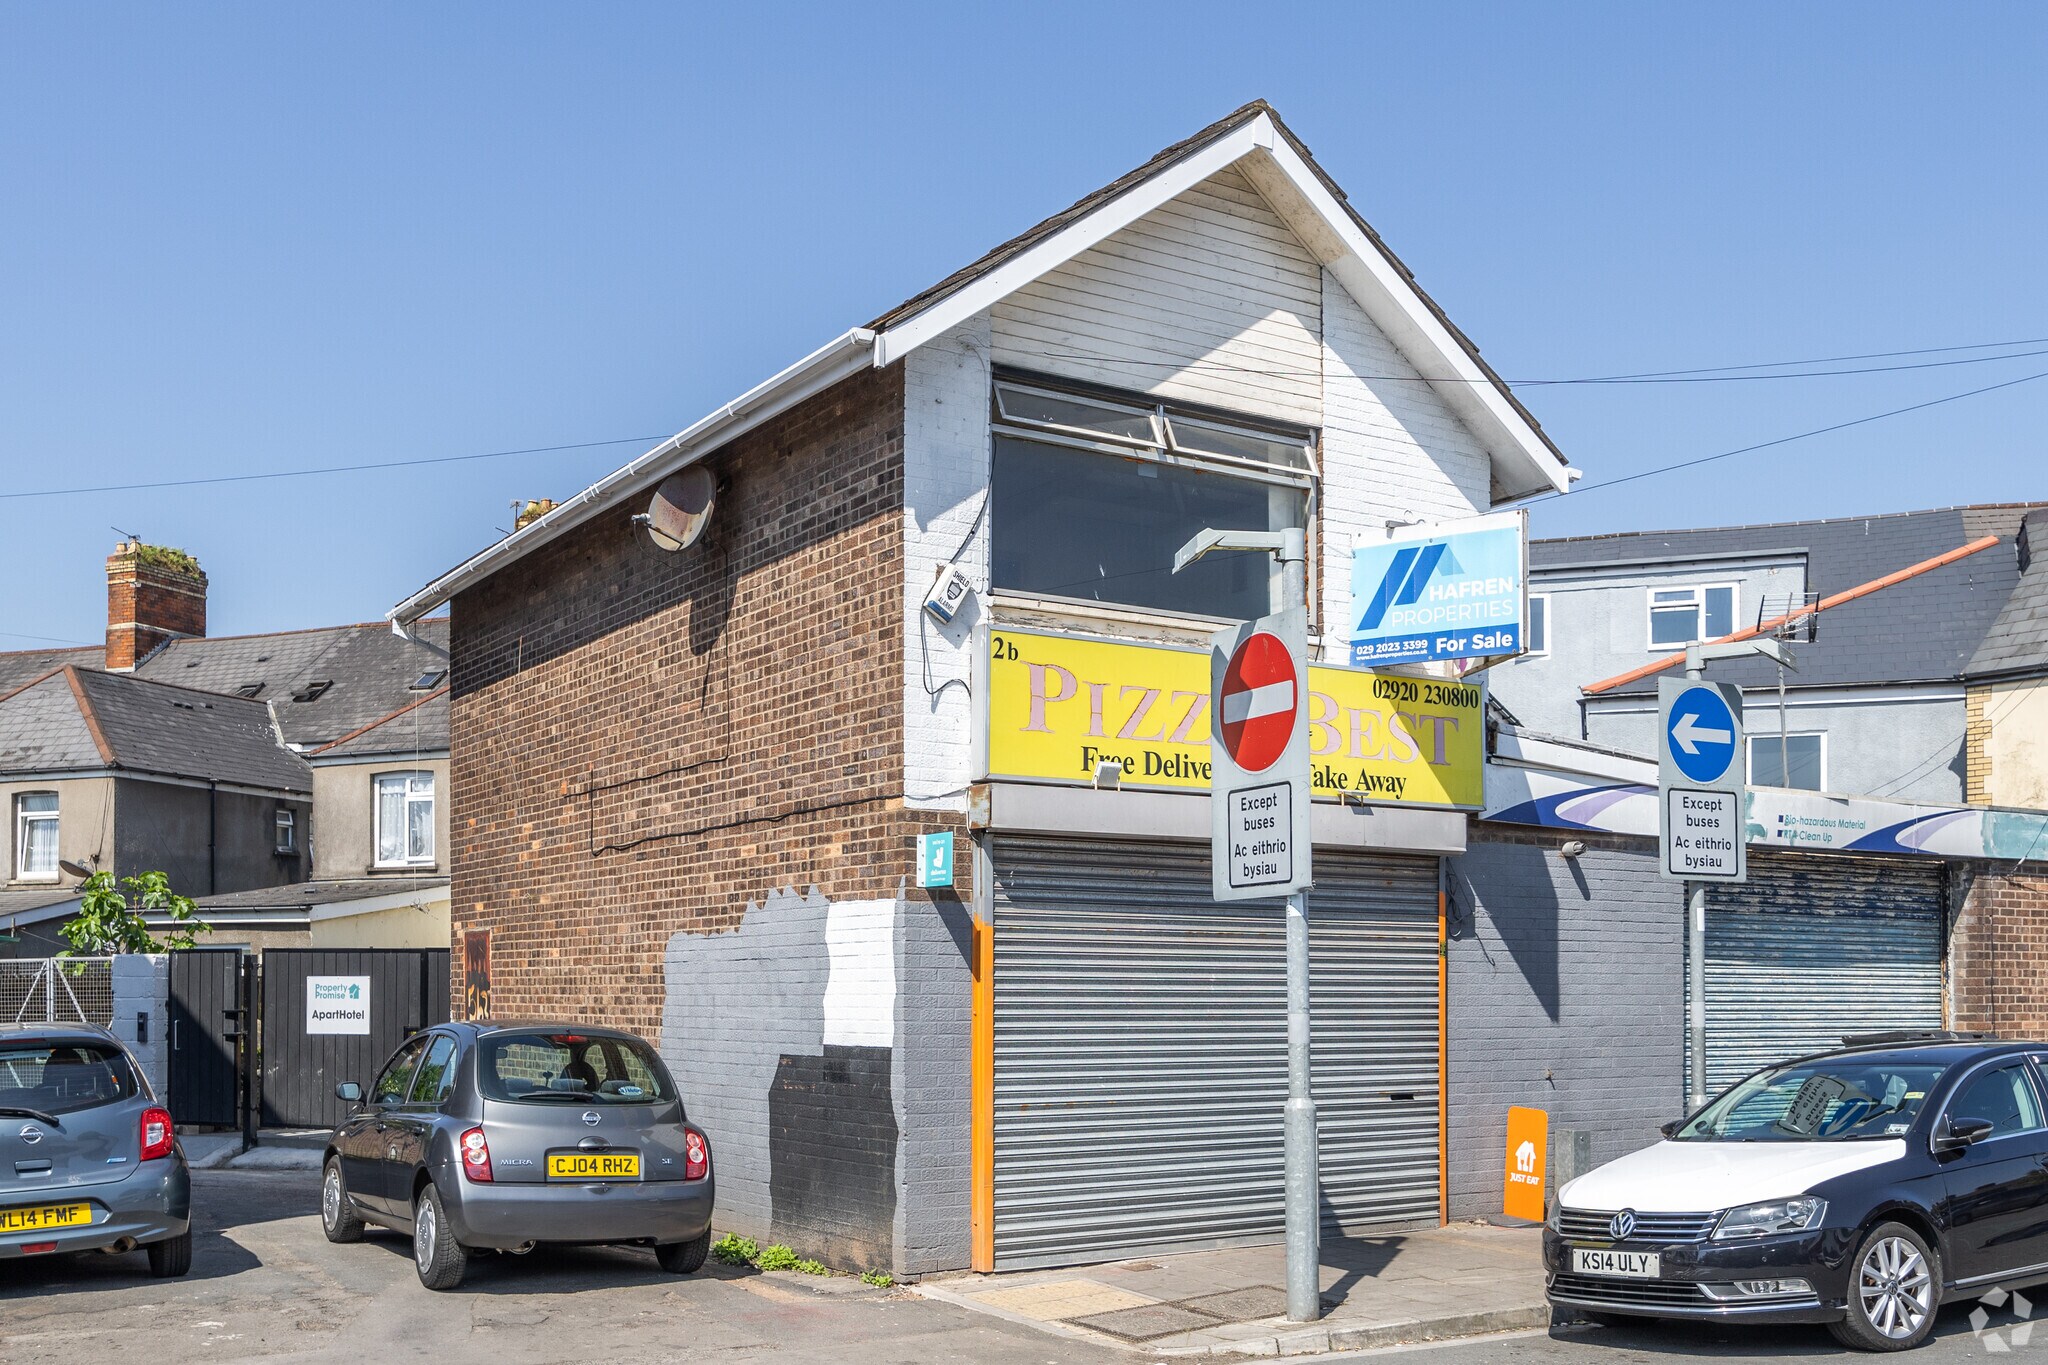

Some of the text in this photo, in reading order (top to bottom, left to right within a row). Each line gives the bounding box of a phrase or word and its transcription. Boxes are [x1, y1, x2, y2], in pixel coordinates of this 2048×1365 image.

[953, 570, 970, 587] SHIELD
[1429, 576, 1513, 602] HAFREN
[1392, 599, 1513, 627] PROPERTIES
[992, 636, 1018, 661] 2b
[1356, 639, 1428, 655] 029 2023 3399
[1436, 631, 1514, 654] For Sale
[1373, 678, 1479, 709] 02920 230800
[1019, 660, 1459, 766] PIZZ BEST
[1143, 750, 1211, 780] Delive
[1355, 768, 1407, 799] Away
[1241, 792, 1278, 811] Except
[1683, 796, 1722, 812] Except
[1244, 816, 1275, 831] buses
[1686, 814, 1720, 828] buses
[1784, 815, 1866, 830] Bio-hazardous Material
[1675, 835, 1732, 851] Ac eithrio
[1799, 830, 1821, 841] Clean
[1823, 832, 1833, 844] Up
[1234, 838, 1286, 858] Ac eithrio
[1243, 861, 1277, 879] bysiau
[1685, 854, 1722, 869] bysiau
[315, 983, 348, 993] Property
[312, 1009, 365, 1021] ApartHotel
[556, 1158, 633, 1173] CJ04 RHZ
[1510, 1172, 1540, 1185] JUST EAT
[43, 1206, 79, 1224] FMF
[1582, 1252, 1648, 1273] KS14 ULY
